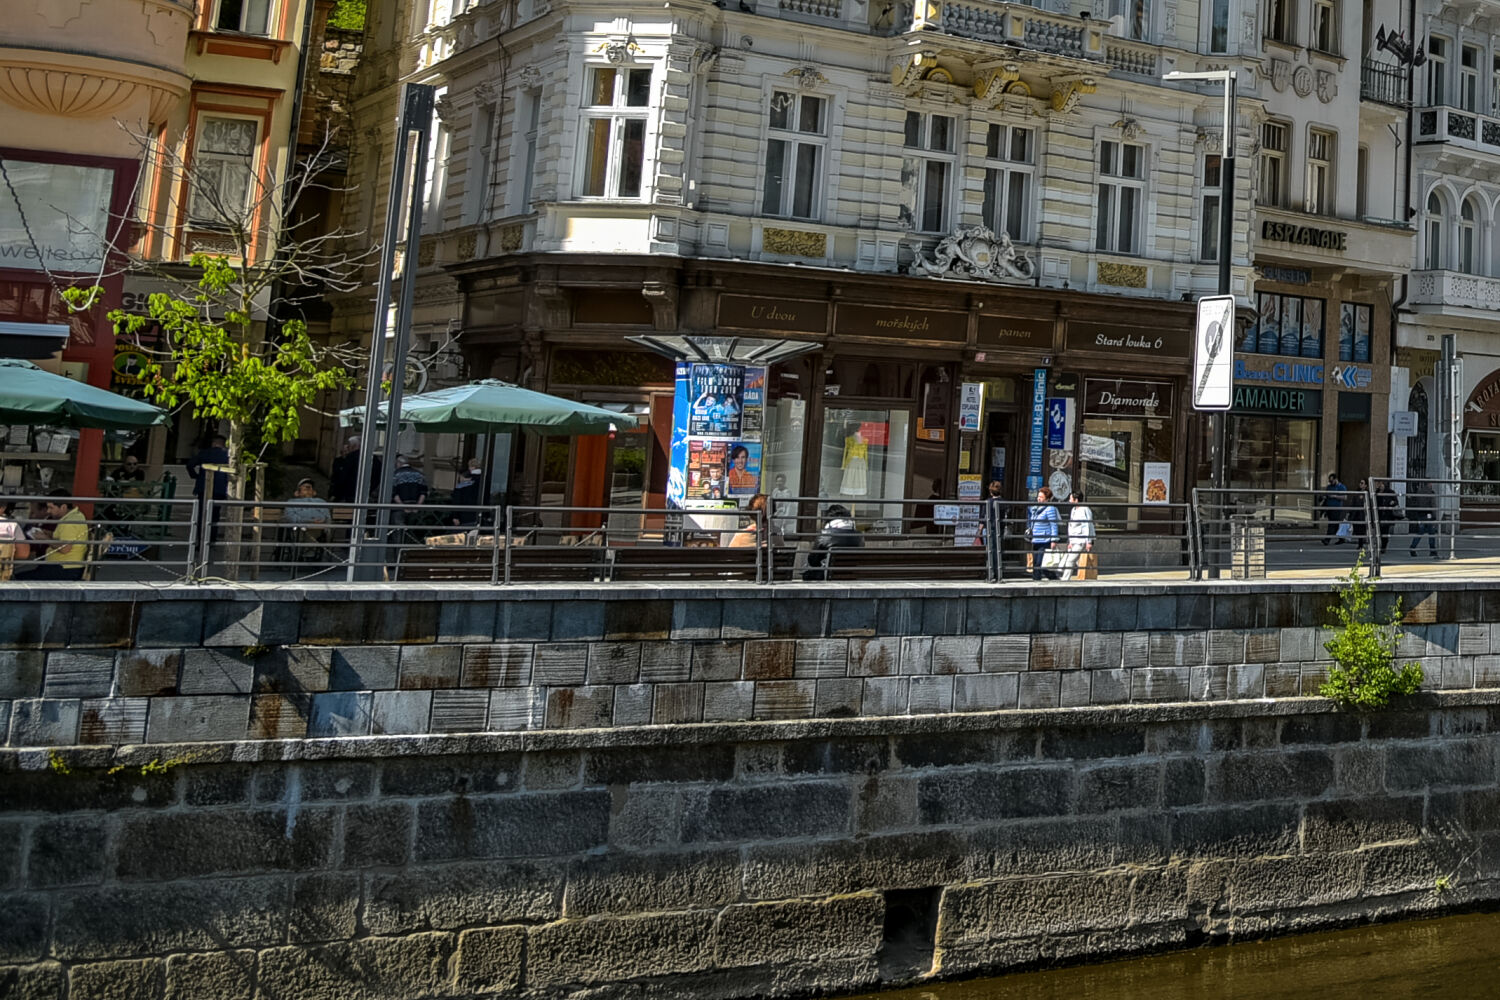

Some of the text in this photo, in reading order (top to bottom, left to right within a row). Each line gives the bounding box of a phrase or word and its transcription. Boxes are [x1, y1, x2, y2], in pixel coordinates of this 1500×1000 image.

[1265, 222, 1348, 251] ESPLANADE
[751, 305, 797, 322] U dvou
[998, 326, 1032, 340] panen
[1095, 333, 1124, 348] Stará
[1125, 334, 1151, 349] louka
[1273, 362, 1324, 384] CLINIC
[1034, 371, 1045, 404] Clinic
[1099, 390, 1160, 409] Diamonds
